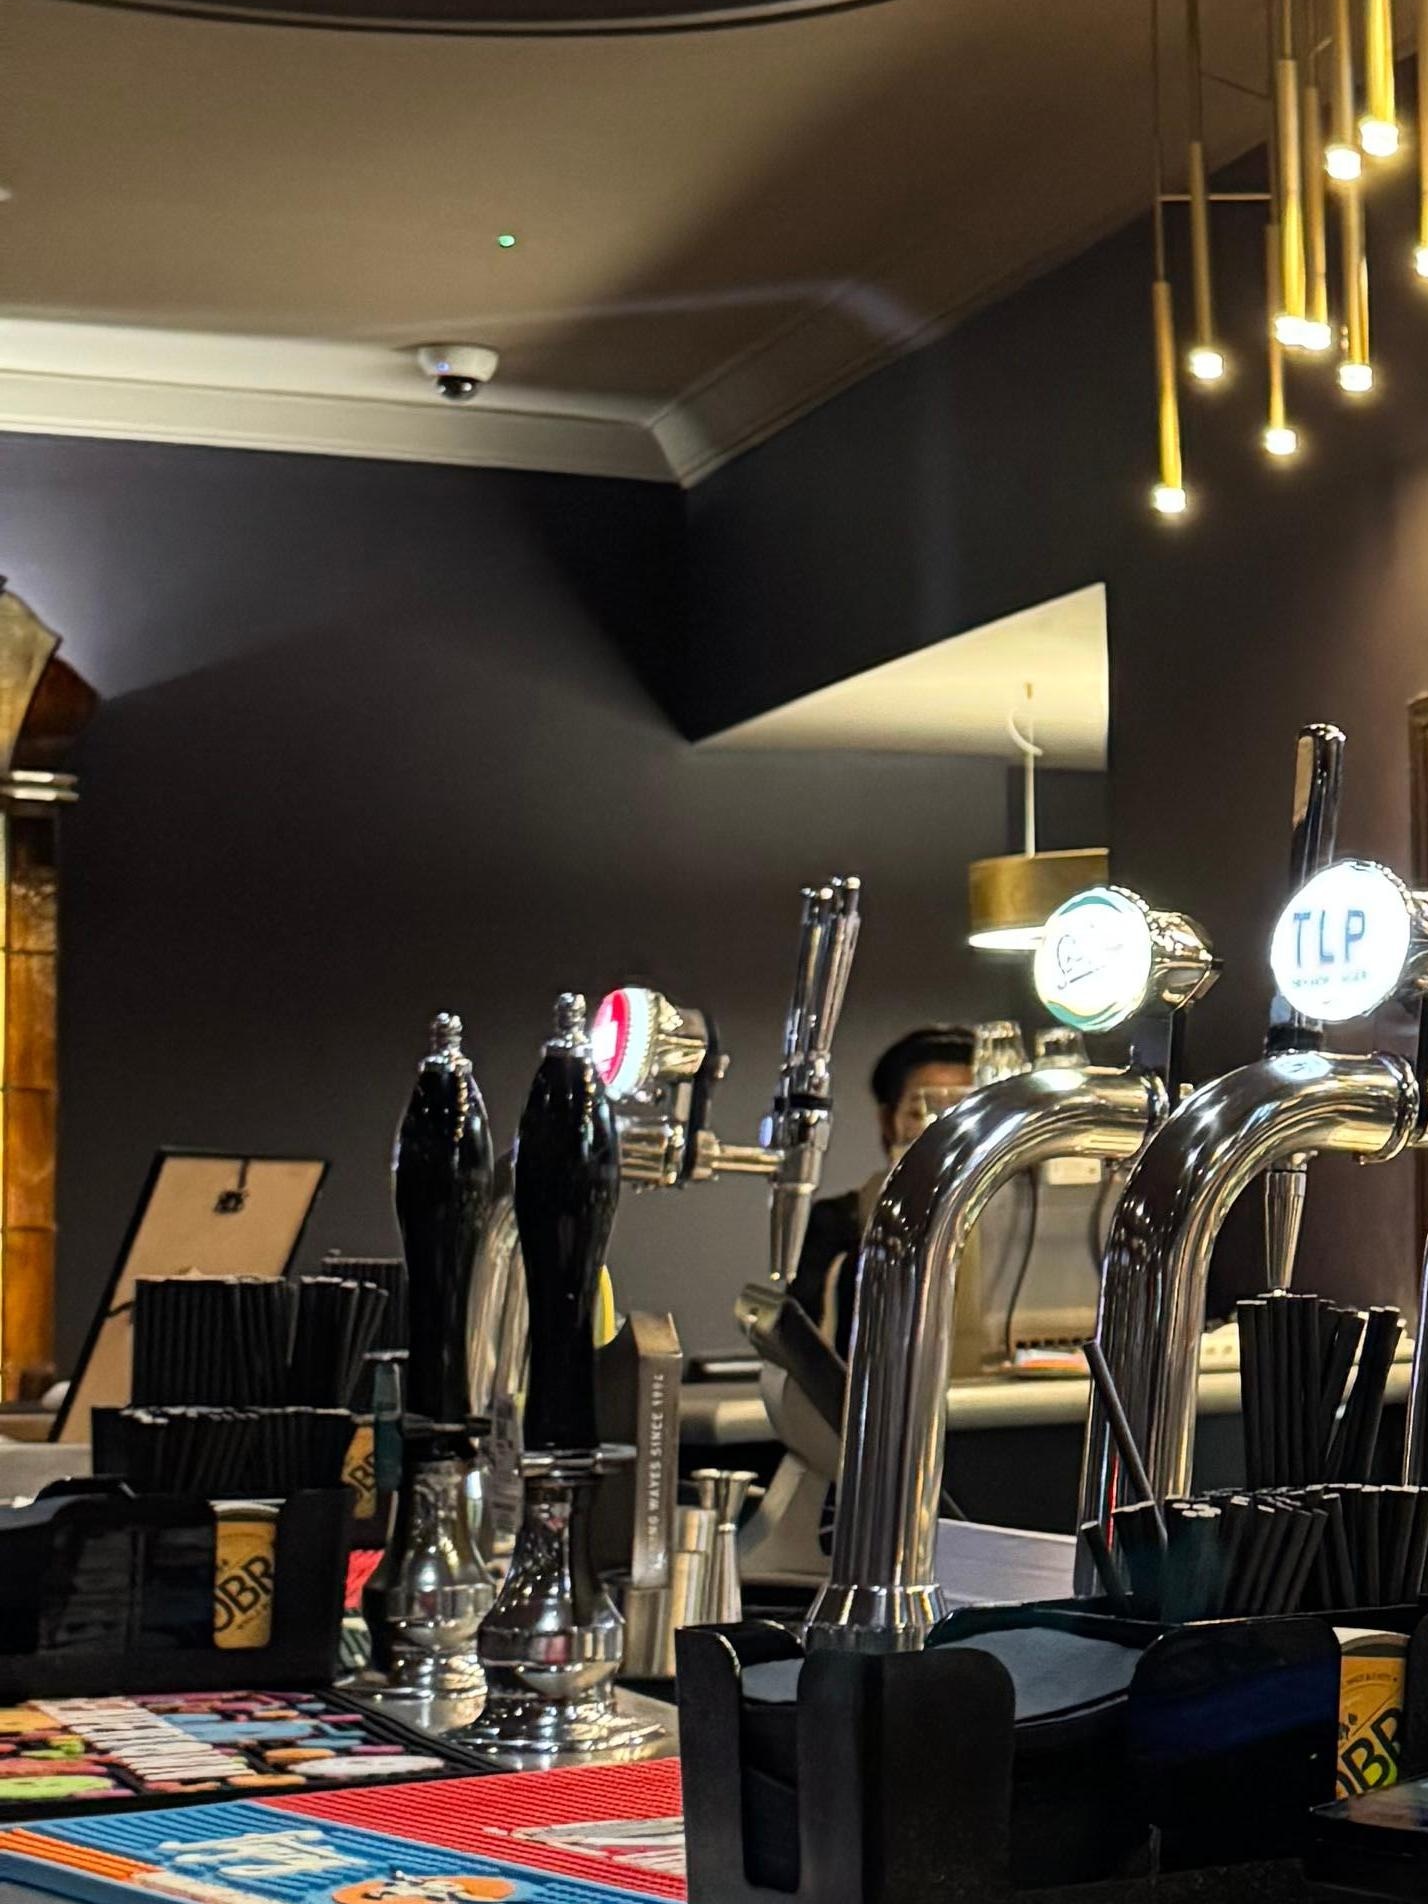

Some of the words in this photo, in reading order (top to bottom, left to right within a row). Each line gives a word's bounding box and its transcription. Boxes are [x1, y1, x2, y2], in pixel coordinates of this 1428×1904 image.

[1293, 909, 1366, 968] TLP
[650, 1412, 663, 1457] SINCE
[648, 1461, 662, 1511] WAVES
